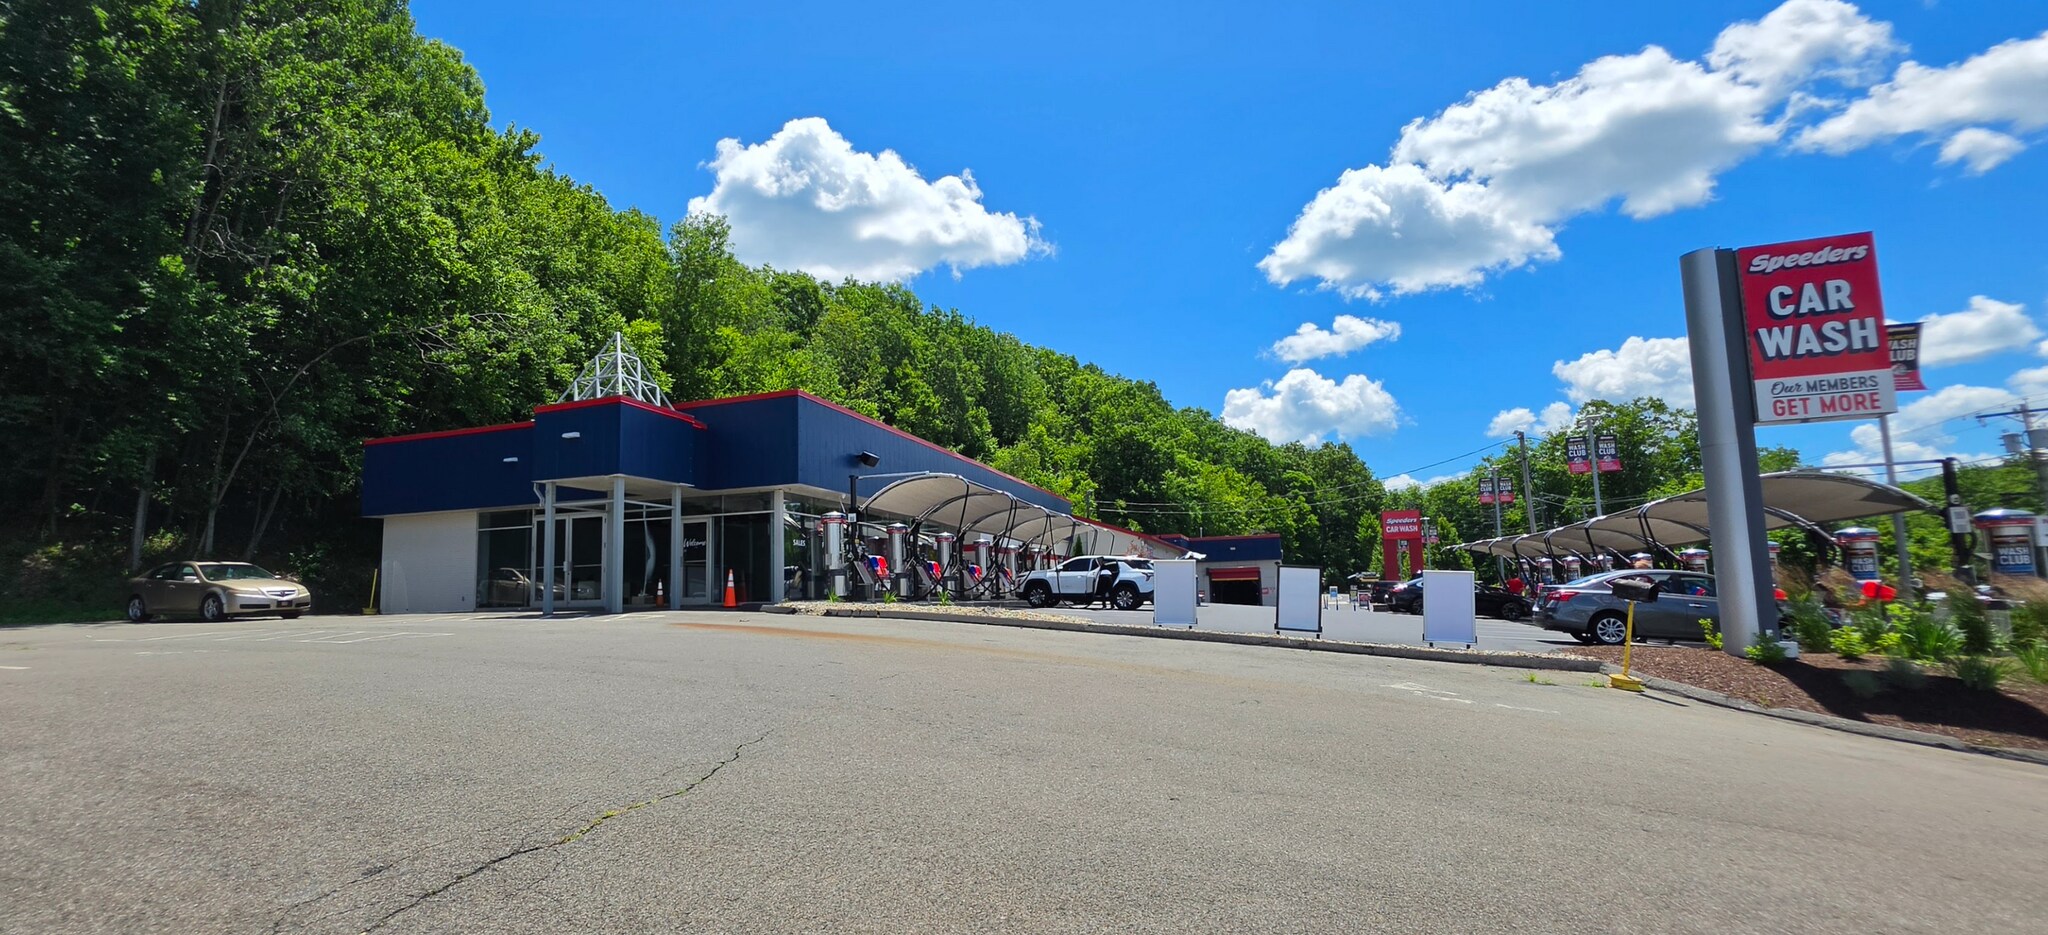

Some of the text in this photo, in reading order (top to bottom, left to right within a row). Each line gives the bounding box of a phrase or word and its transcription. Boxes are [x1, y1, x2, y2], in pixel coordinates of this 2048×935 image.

[1748, 245, 1869, 274] Speeders
[1768, 279, 1856, 317] CAR
[1756, 317, 1880, 361] WASH
[1889, 349, 1916, 361] LUB
[1771, 380, 1803, 396] Our
[1806, 375, 1879, 393] MEMBERS
[1772, 392, 1882, 417] GET MORE
[1386, 517, 1417, 525] Speeders
[683, 538, 706, 548] Welcome
[1998, 547, 2029, 555] WASH
[1999, 555, 2031, 565] CLUB
[1851, 564, 1876, 572] CLUB
